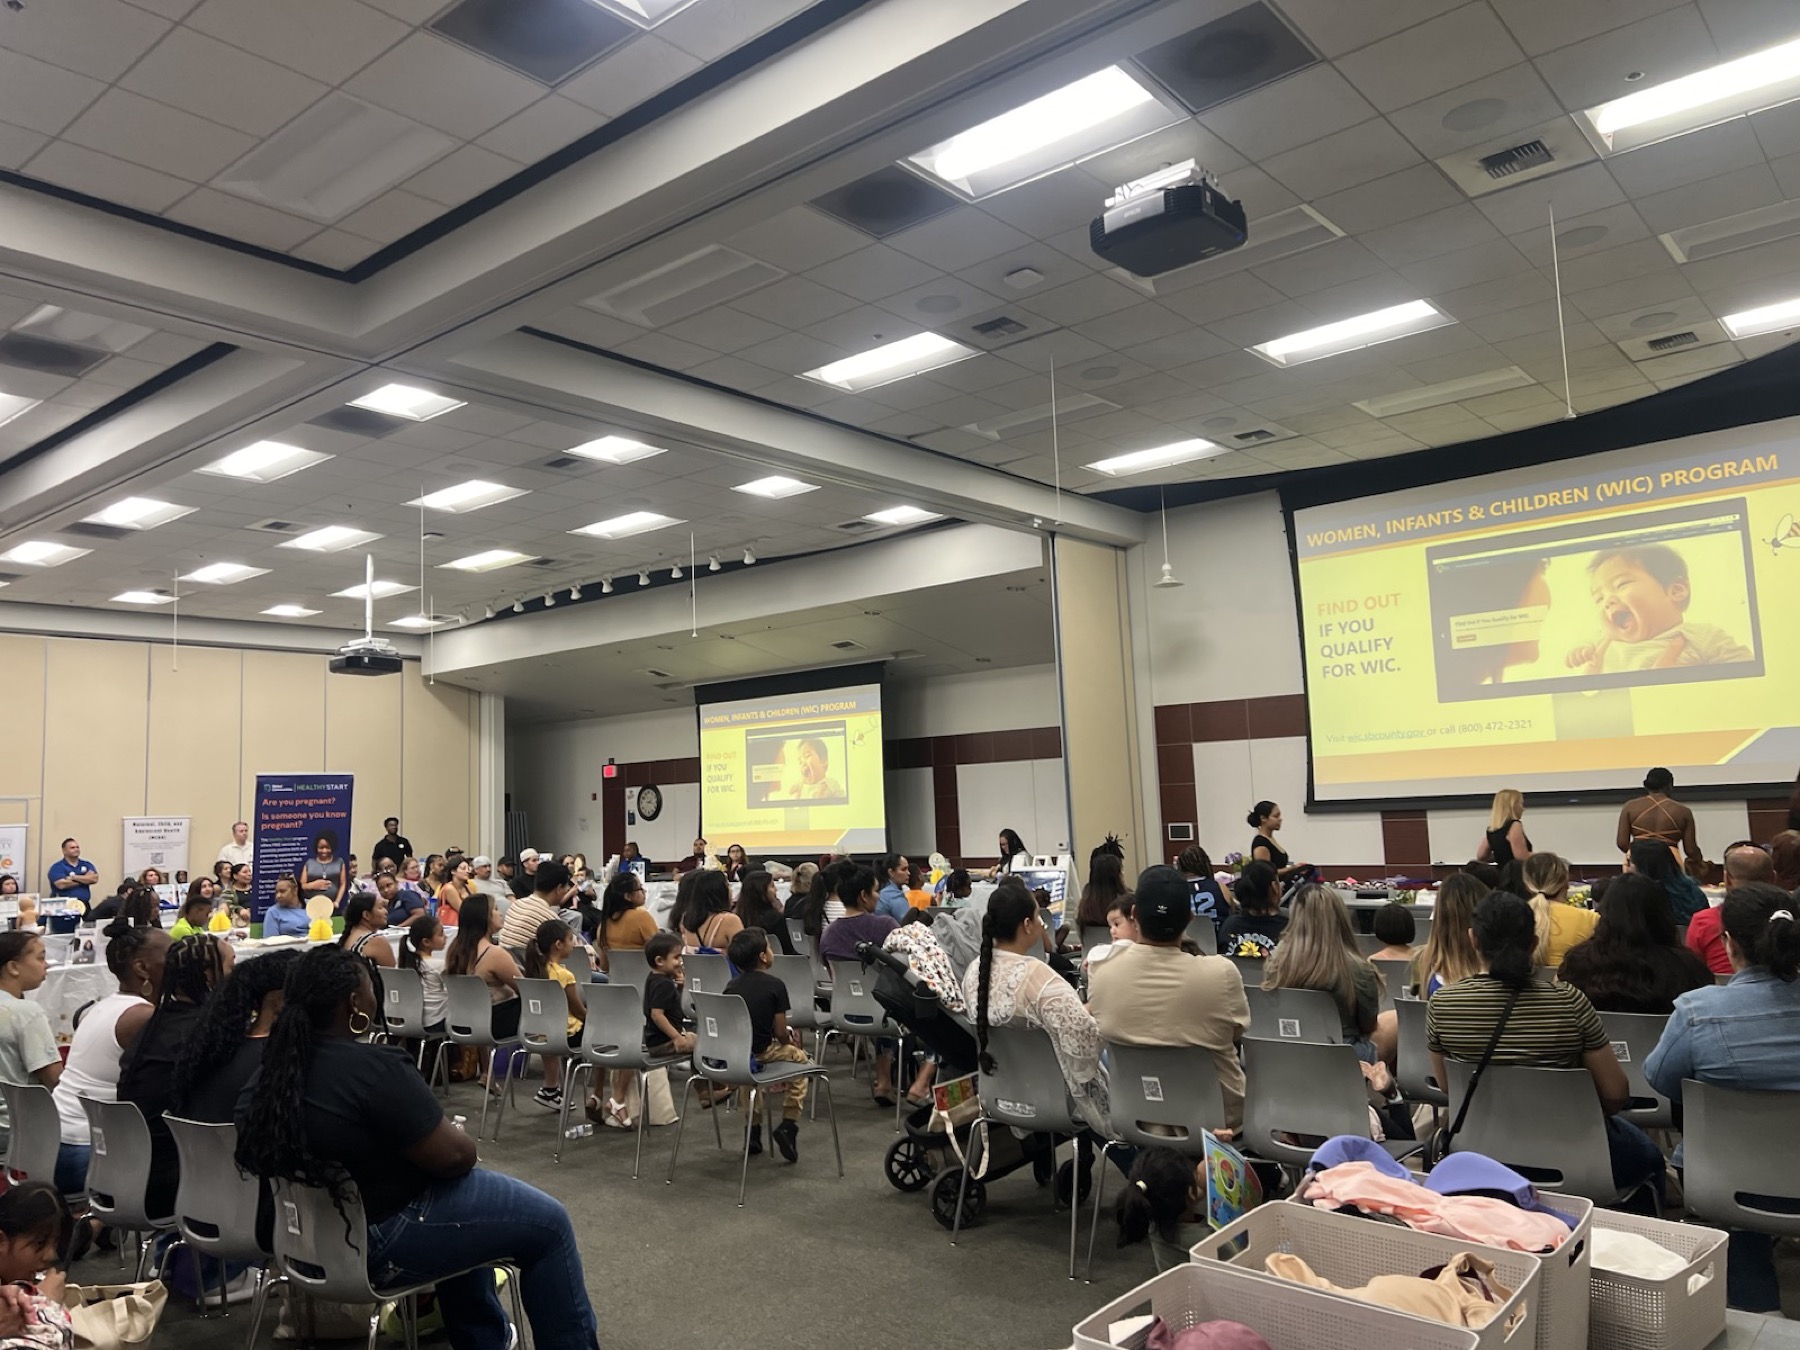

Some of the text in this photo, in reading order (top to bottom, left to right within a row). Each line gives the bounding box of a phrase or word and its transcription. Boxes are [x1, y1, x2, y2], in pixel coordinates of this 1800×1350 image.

[1306, 453, 1779, 548] WOMEN, INFANTS & CHILDREN (WIC) PROGRAM
[1317, 592, 1401, 617] FIND OUT
[1319, 618, 1375, 638] IF YOU
[1320, 636, 1394, 659] QUALIFY
[1322, 657, 1401, 679] FOR WIC.
[820, 701, 857, 713] PROGRAM
[1326, 734, 1346, 744] Visit
[1426, 727, 1437, 736] or
[1439, 725, 1456, 736] call
[1458, 723, 1483, 734] (800)
[1485, 719, 1533, 732] 472-2321
[262, 797, 336, 807] Are you pregnant?
[261, 820, 303, 831] pregnant?
[270, 812, 307, 820] someone
[308, 812, 324, 820] you
[325, 810, 347, 818] know
